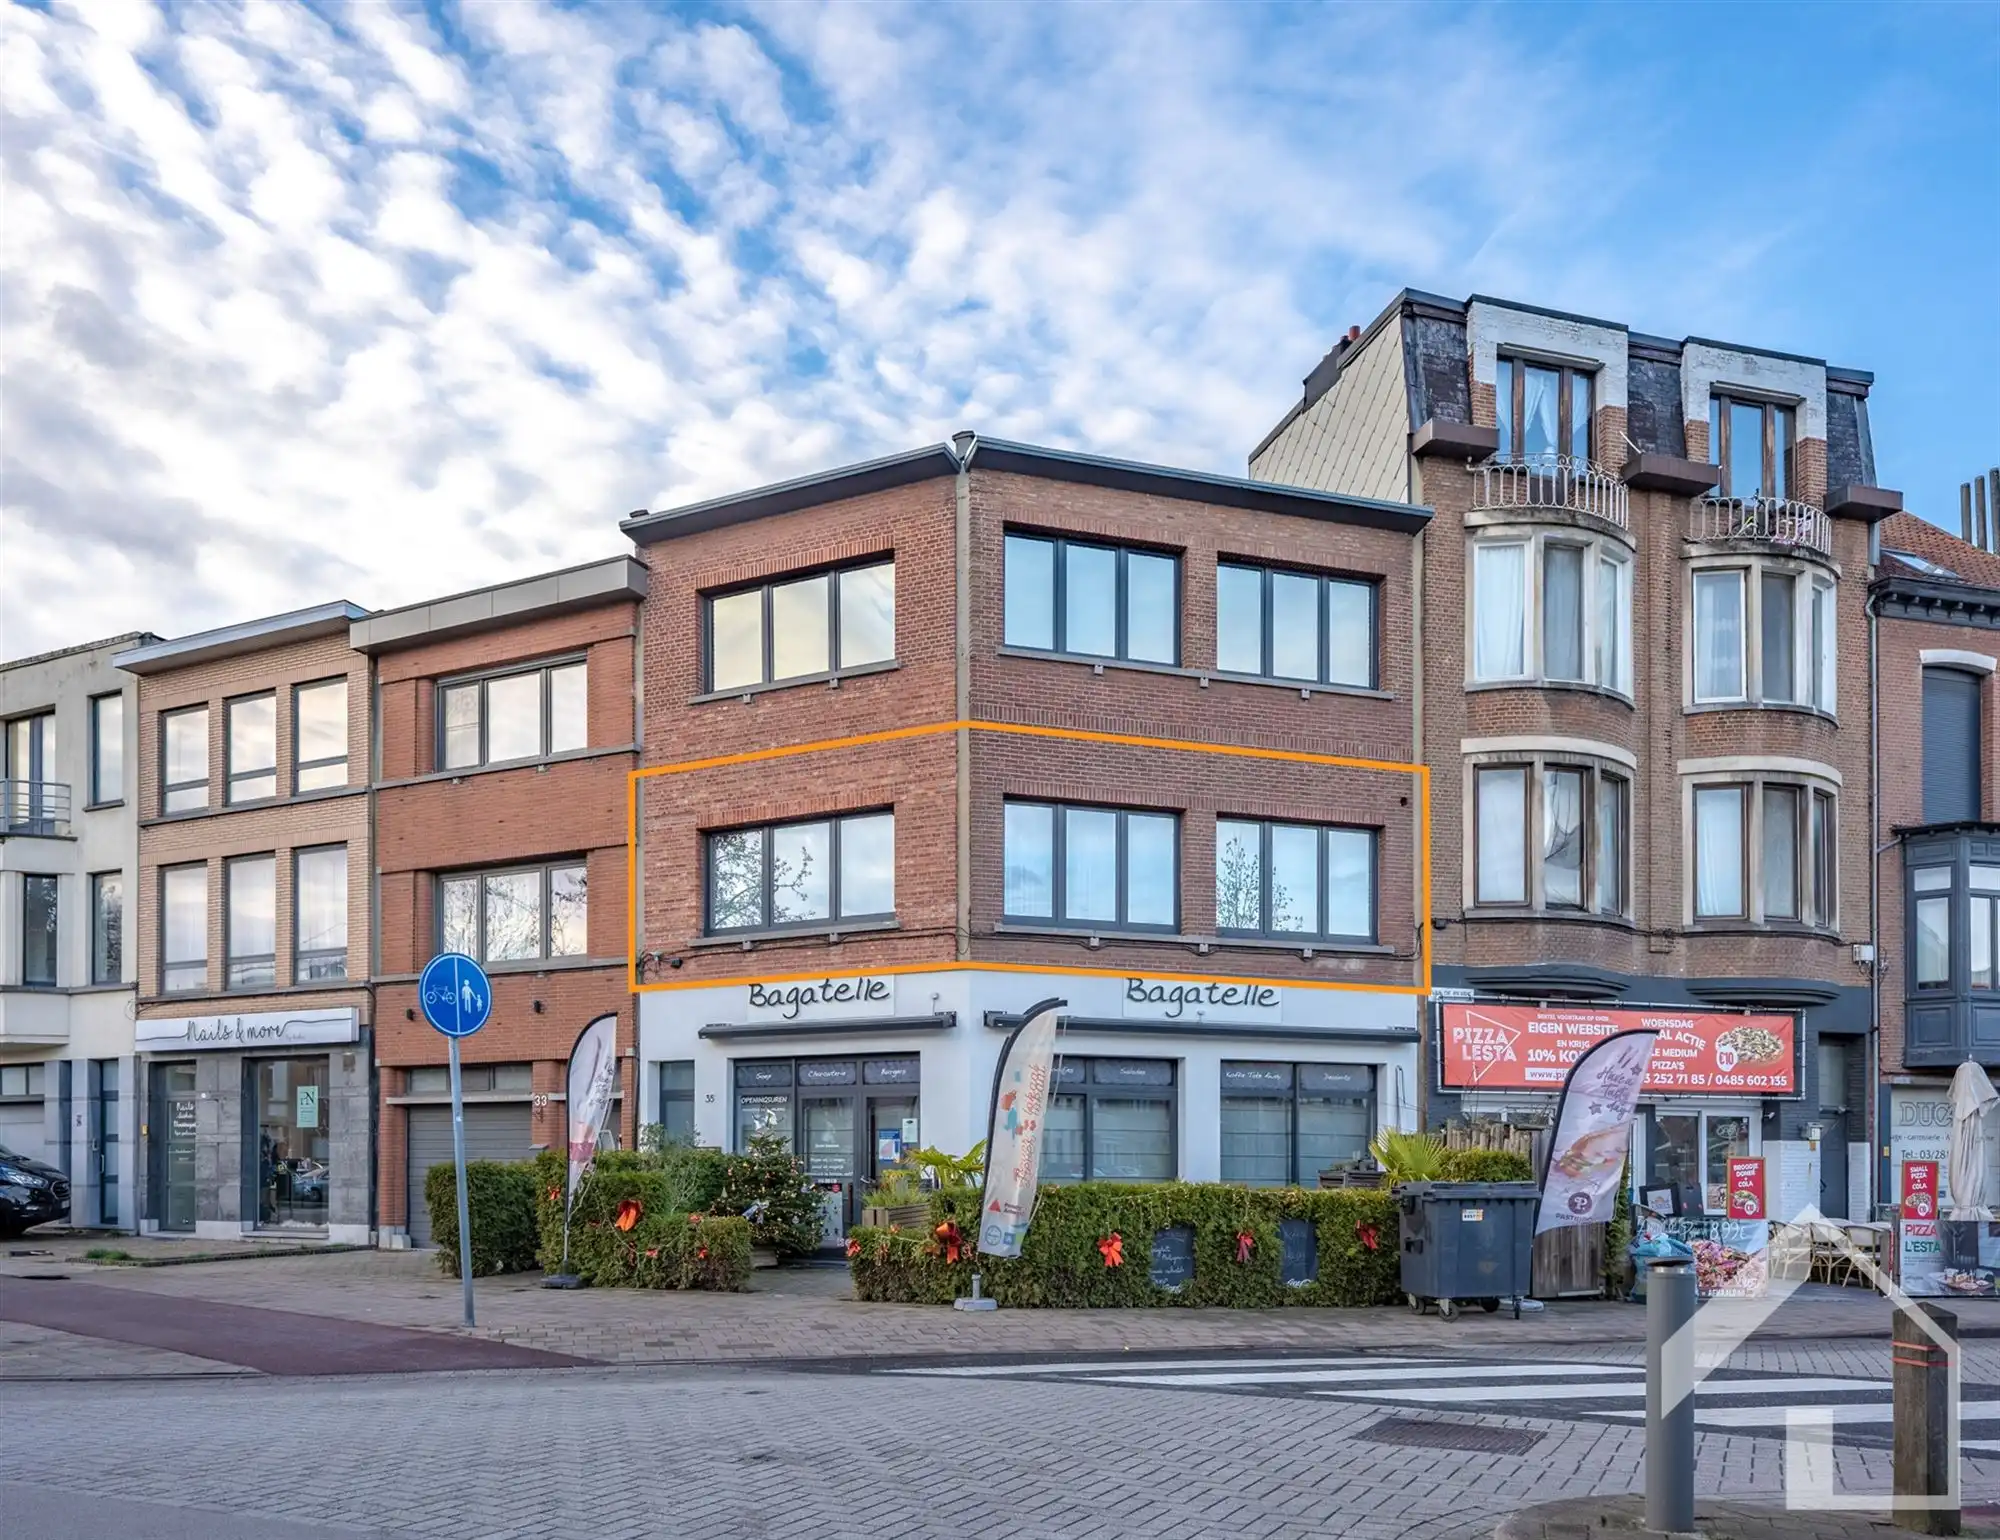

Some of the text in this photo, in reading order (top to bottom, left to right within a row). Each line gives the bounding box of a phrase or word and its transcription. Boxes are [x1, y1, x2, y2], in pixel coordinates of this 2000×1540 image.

[748, 977, 890, 1019] Bagatelle
[1126, 978, 1280, 1018] Bagatelle
[1528, 1021, 1619, 1035] EIGEN WEBSITE
[1641, 1018, 1694, 1029] WOENSDAG
[185, 1018, 232, 1042] Nails
[246, 1024, 285, 1038] more
[1452, 1027, 1508, 1044] PIZZA
[1569, 1040, 1590, 1048] KRIJG
[1656, 1030, 1706, 1050] AL ACTIE
[1462, 1045, 1517, 1061] LESTA
[1528, 1050, 1582, 1062] 10% KO
[1662, 1048, 1698, 1058] MEDIUM
[1652, 1060, 1685, 1070] PIZZA'S
[1530, 1071, 1568, 1080] www.pi
[1597, 1065, 1625, 1085] Have
[1654, 1073, 1674, 1084] 252
[1677, 1074, 1688, 1084] 71
[1691, 1074, 1705, 1085] 85
[1715, 1074, 1744, 1085] 0485
[1747, 1075, 1767, 1086] 602
[1770, 1075, 1787, 1086] 135
[534, 1095, 548, 1106] 33
[704, 1094, 715, 1103] 35
[740, 1096, 788, 1104] OPENINGSUREN
[1919, 1150, 1949, 1159] 03/28
[1910, 1165, 1928, 1173] SMALL
[1905, 1223, 1937, 1236] PIZZA
[1904, 1241, 1941, 1253] L'ESTA
